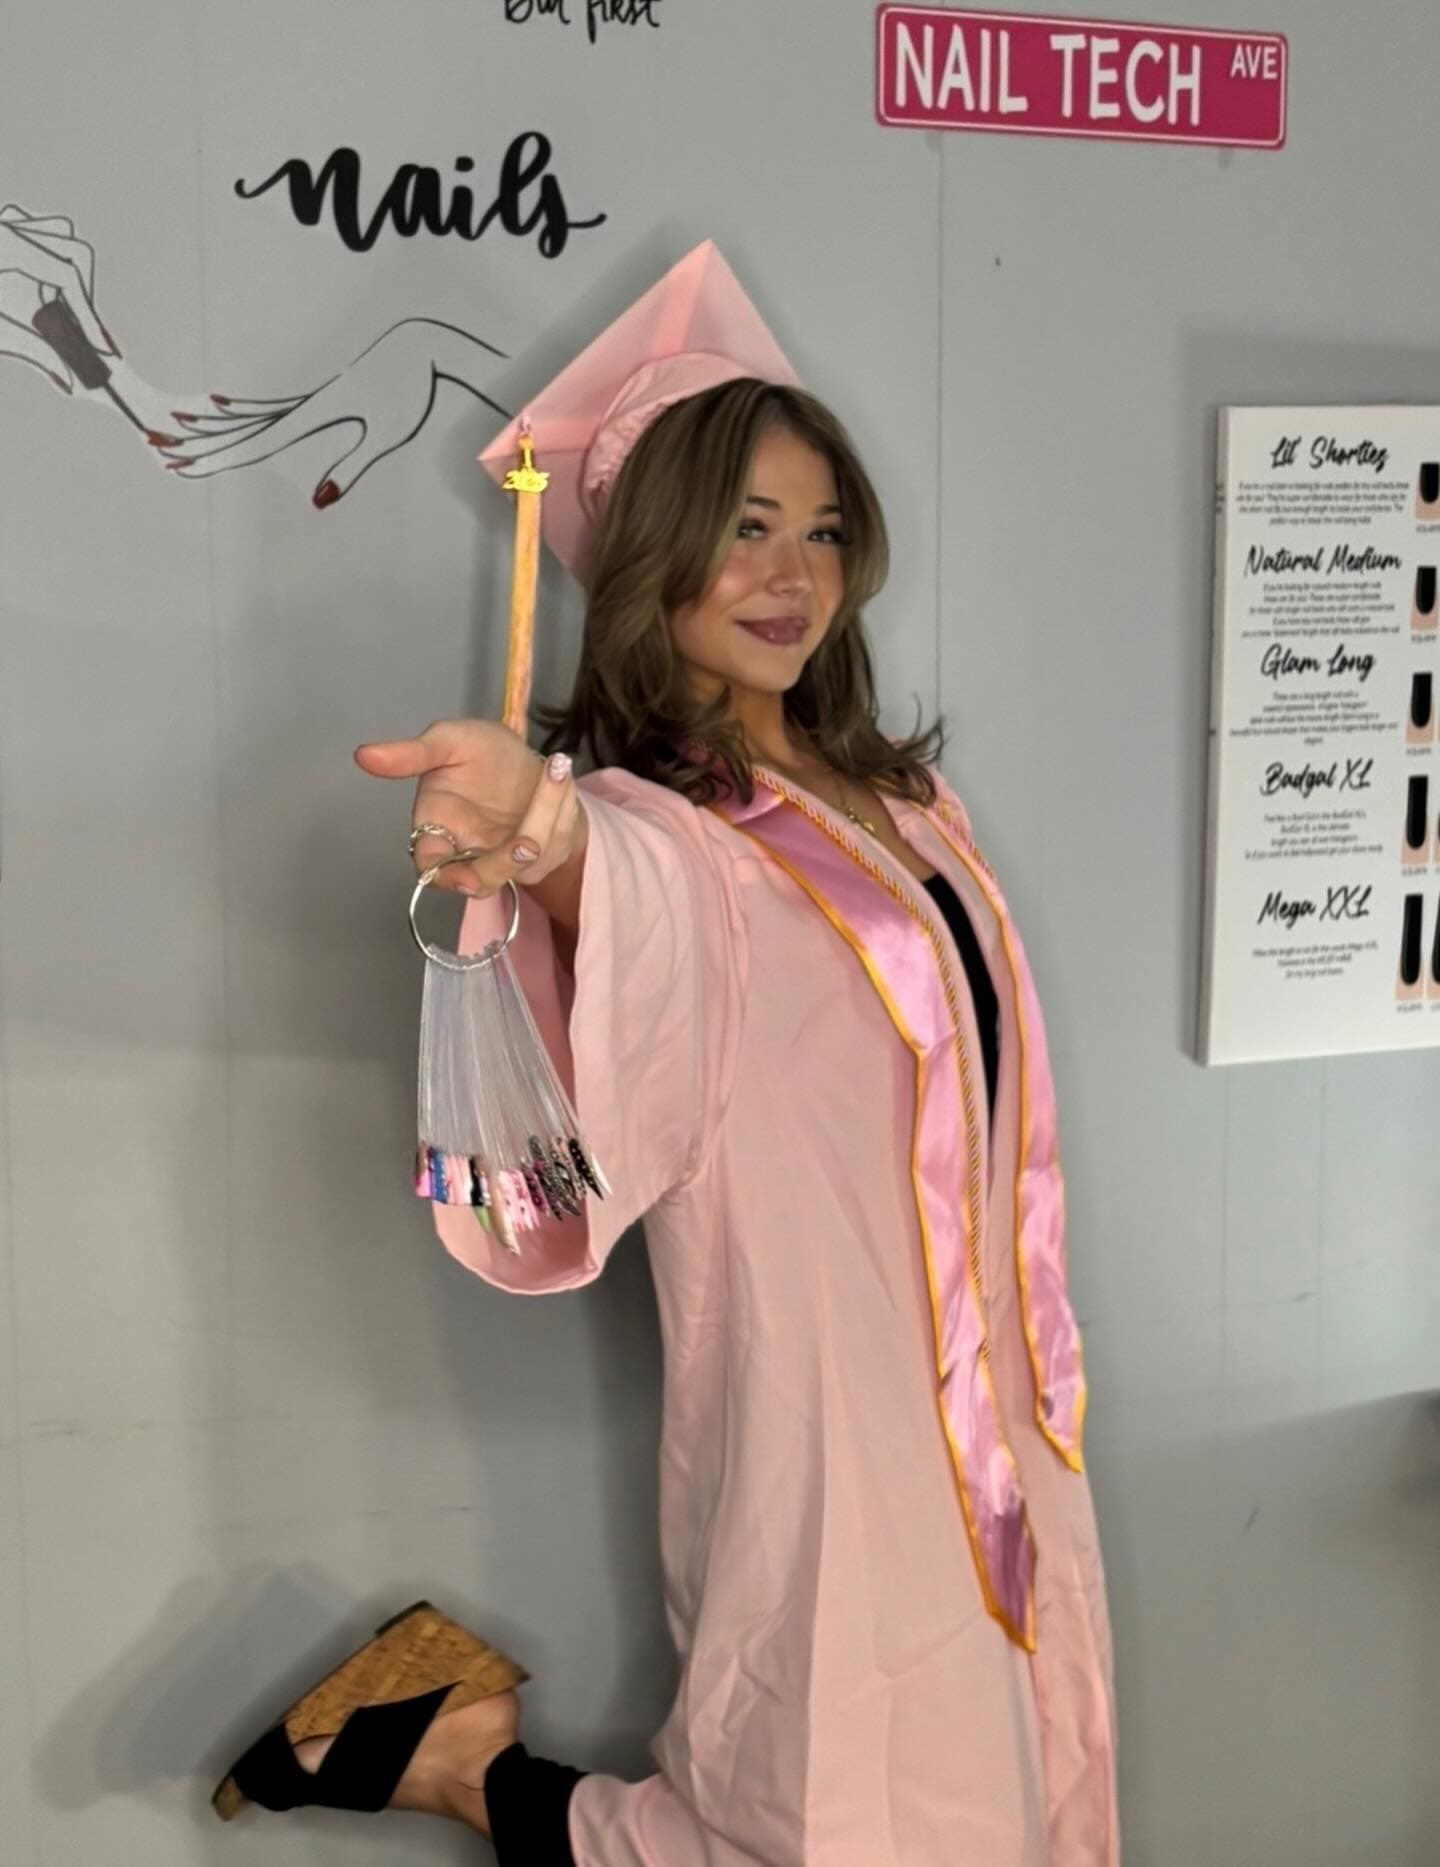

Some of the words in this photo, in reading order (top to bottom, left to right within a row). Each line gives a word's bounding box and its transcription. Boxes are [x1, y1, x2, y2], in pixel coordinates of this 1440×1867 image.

[894, 22, 1028, 112] NAIL
[1049, 34, 1201, 126] TECH
[1230, 44, 1279, 79] AVE
[234, 131, 607, 258] nails
[1308, 434, 1389, 473] Shorties
[1243, 544, 1324, 579] Natural
[1326, 543, 1402, 576] Medium
[1261, 642, 1320, 682] Glam
[1327, 642, 1375, 683] Long
[1259, 760, 1337, 800] Badgal
[1338, 757, 1374, 792] XL
[1256, 889, 1317, 930] Mega
[1319, 884, 1373, 922] XXL
